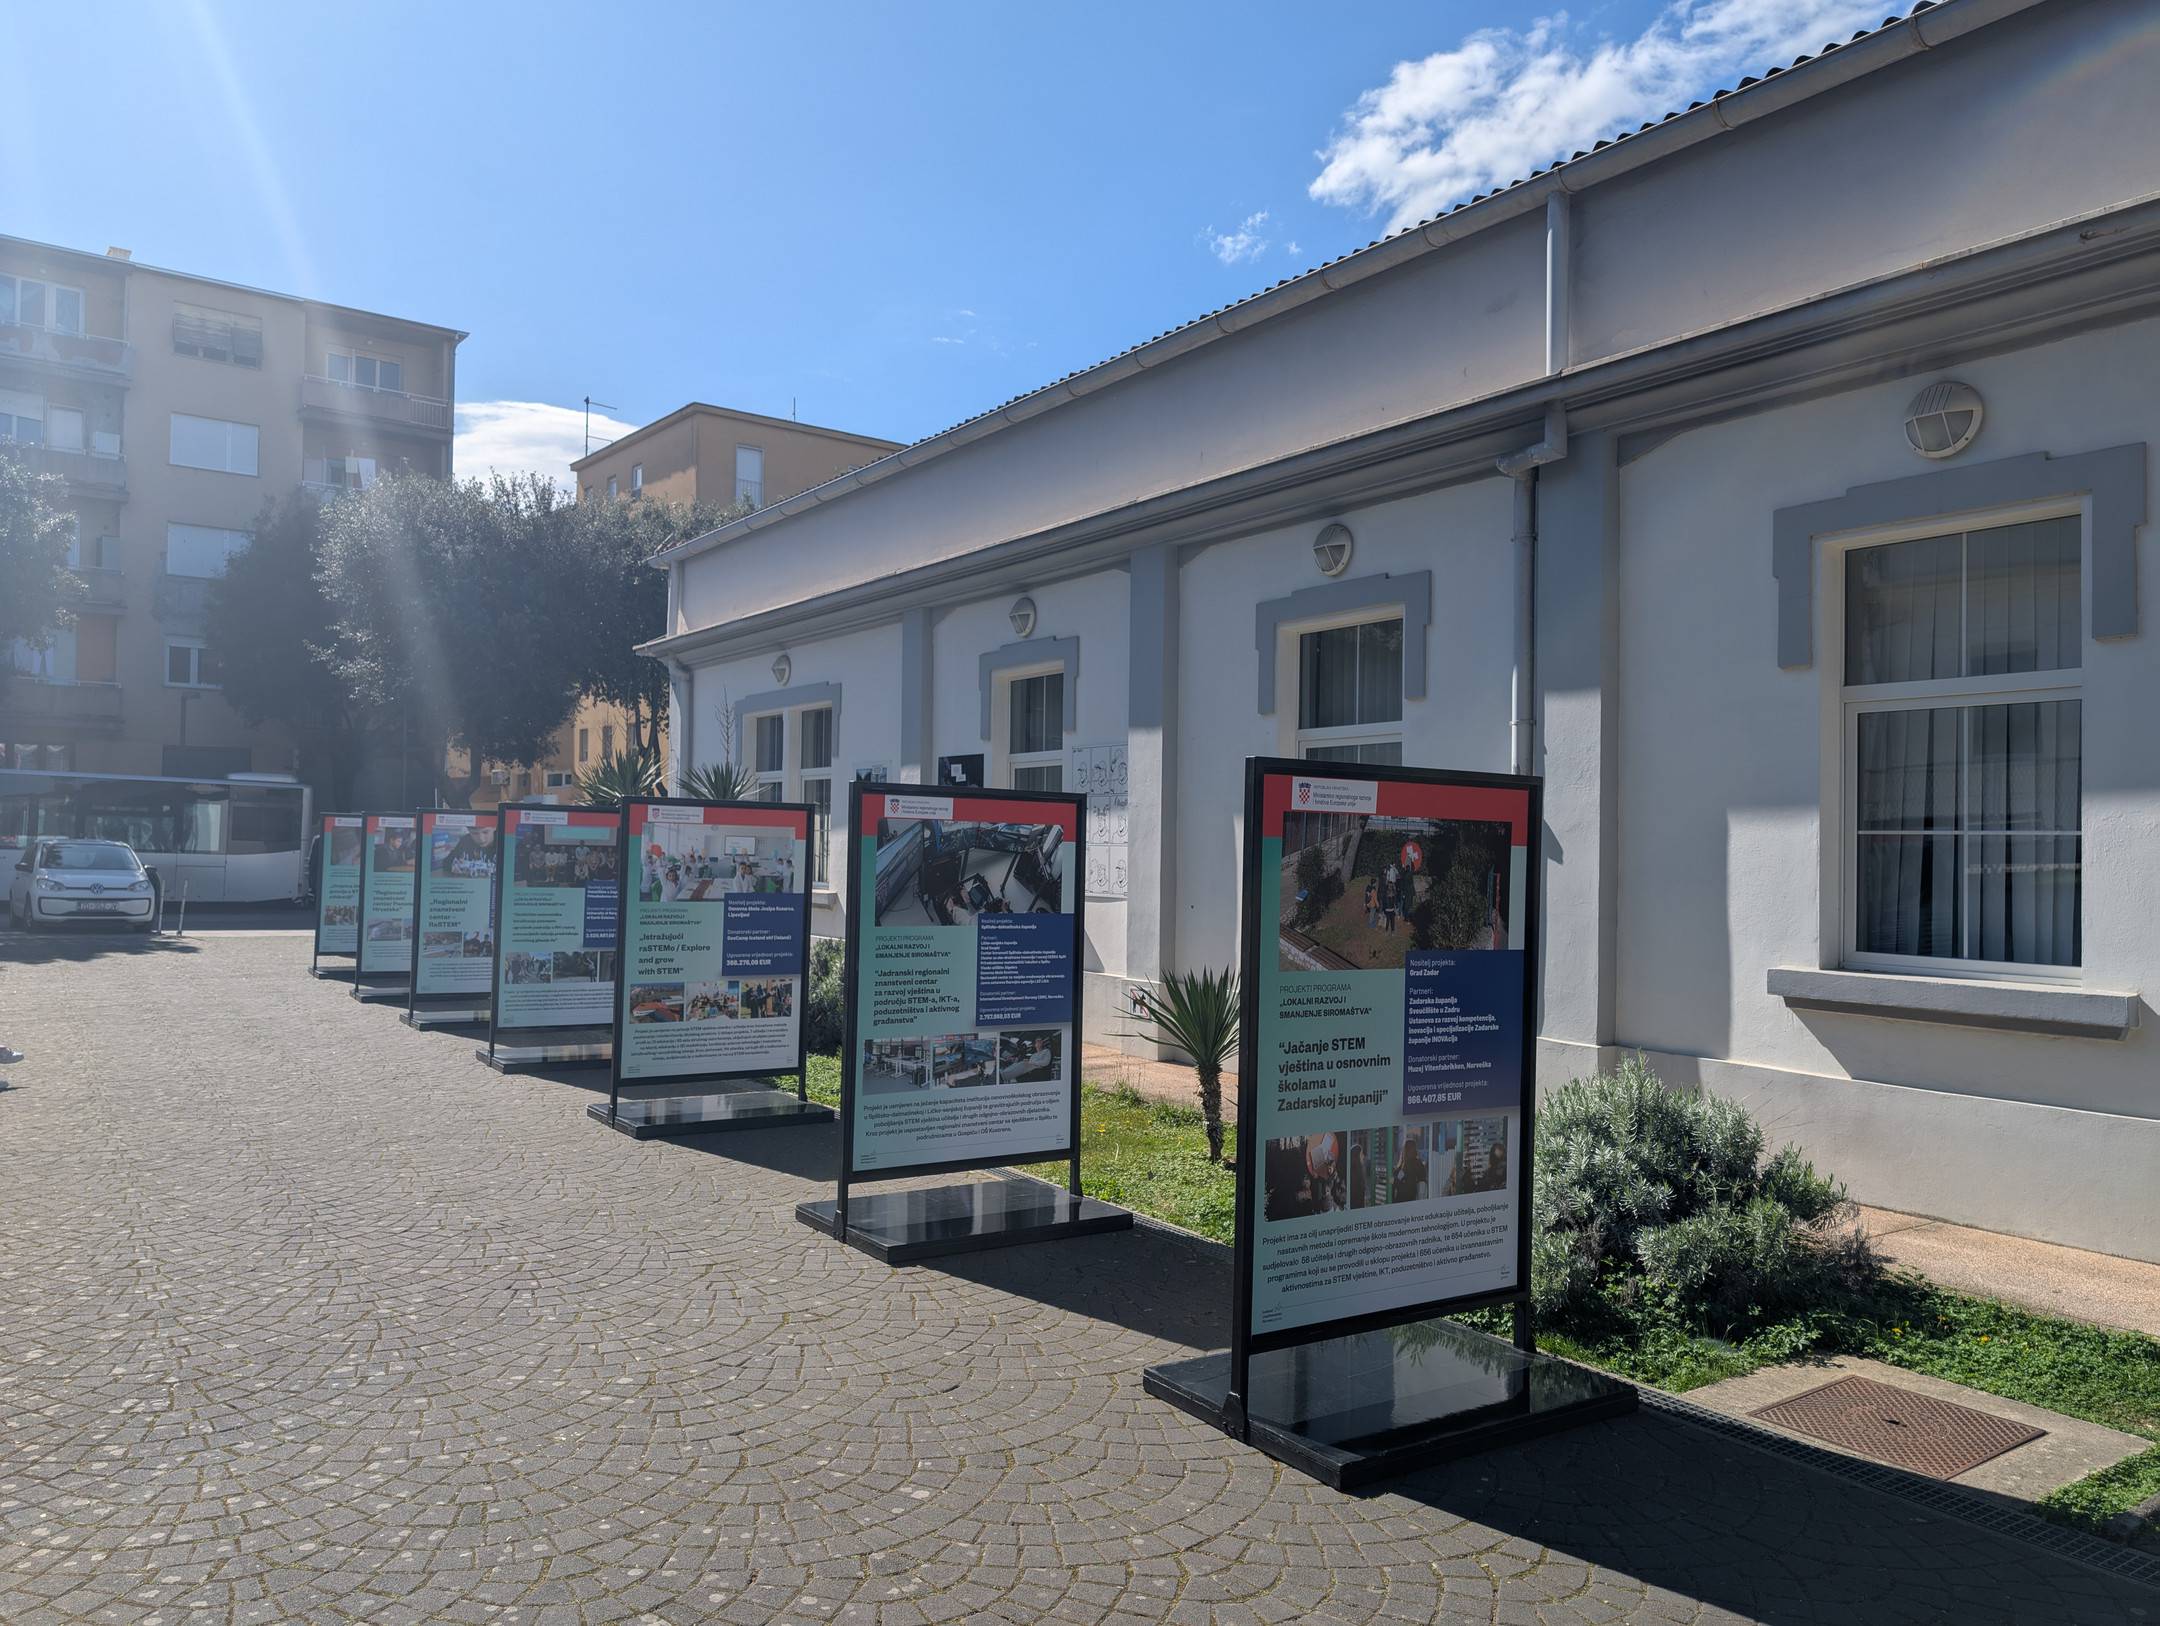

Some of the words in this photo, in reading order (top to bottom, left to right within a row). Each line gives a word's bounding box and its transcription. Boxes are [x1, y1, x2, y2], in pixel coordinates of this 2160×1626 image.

[639, 944, 674, 952] raSTEMo
[681, 944, 710, 952] Explore
[1410, 959, 1430, 968] Nositelj
[1431, 959, 1456, 967] projekta:
[915, 968, 949, 977] regionalni
[884, 988, 905, 997] razvoj
[907, 987, 934, 996] vještina
[1279, 985, 1312, 993] PROJEKTI
[1313, 984, 1351, 992] PROGRAMA
[1409, 987, 1433, 995] Partneri:
[873, 999, 906, 1007] području
[907, 996, 937, 1004] STEM-a,
[938, 995, 959, 1003] IKT-a,
[1314, 996, 1343, 1004] RAZVOJ
[1435, 996, 1457, 1005] županija
[873, 1007, 924, 1017] poduzetništva
[929, 1005, 959, 1014] aktivnog
[1279, 1009, 1322, 1018] SMANJENJE
[1409, 1006, 1439, 1014] Sveučilište
[1442, 1016, 1458, 1024] razvoj
[1436, 1024, 1473, 1034] specijalizacije
[1331, 1036, 1365, 1051] STEM
[1408, 1036, 1430, 1045] županije
[1408, 1053, 1437, 1063] Donatorski
[1438, 1053, 1460, 1062] partner:
[1278, 1057, 1326, 1076] vještina
[1326, 1060, 1333, 1069] u
[1335, 1053, 1390, 1069] osnovnim
[1407, 1065, 1423, 1074] Muzej
[1466, 1060, 1491, 1069] Norveška
[1278, 1076, 1327, 1092] školama
[1328, 1078, 1336, 1088] u
[1407, 1082, 1436, 1092] Ugovorena
[1447, 1091, 1462, 1101] EUR
[1277, 1094, 1335, 1113] Zadarskoj
[1262, 1235, 1285, 1246] Projekt
[1286, 1232, 1298, 1241] ima
[1308, 1229, 1317, 1239] cilj
[1318, 1225, 1353, 1237] unaprijediti
[1354, 1222, 1372, 1231] STEM
[1373, 1217, 1409, 1229] obrazovanje
[1411, 1214, 1423, 1222] kroz
[1425, 1211, 1452, 1222] edukaciju
[1277, 1244, 1307, 1255] nastavnih
[1309, 1241, 1332, 1250] metoda
[1337, 1235, 1369, 1247] opremanje
[1370, 1231, 1387, 1240] škola
[1387, 1227, 1420, 1238] modernom
[1466, 1217, 1490, 1227] projektu
[1490, 1215, 1496, 1223] je
[1262, 1258, 1298, 1272] sudjelovalo
[1311, 1253, 1333, 1263] učitelja
[1338, 1249, 1357, 1258] drugih
[1463, 1229, 1485, 1237] učenika
[1491, 1225, 1507, 1233] STEM
[1267, 1270, 1307, 1283] programima
[1308, 1267, 1319, 1277] koji
[1337, 1260, 1363, 1271] provodili
[1370, 1256, 1390, 1266] sklopu
[1390, 1251, 1415, 1262] projekta
[1432, 1245, 1454, 1254] učenika
[1281, 1280, 1323, 1292] aktivnostima
[1332, 1274, 1351, 1283] STEM
[1436, 1256, 1458, 1265] aktivno
